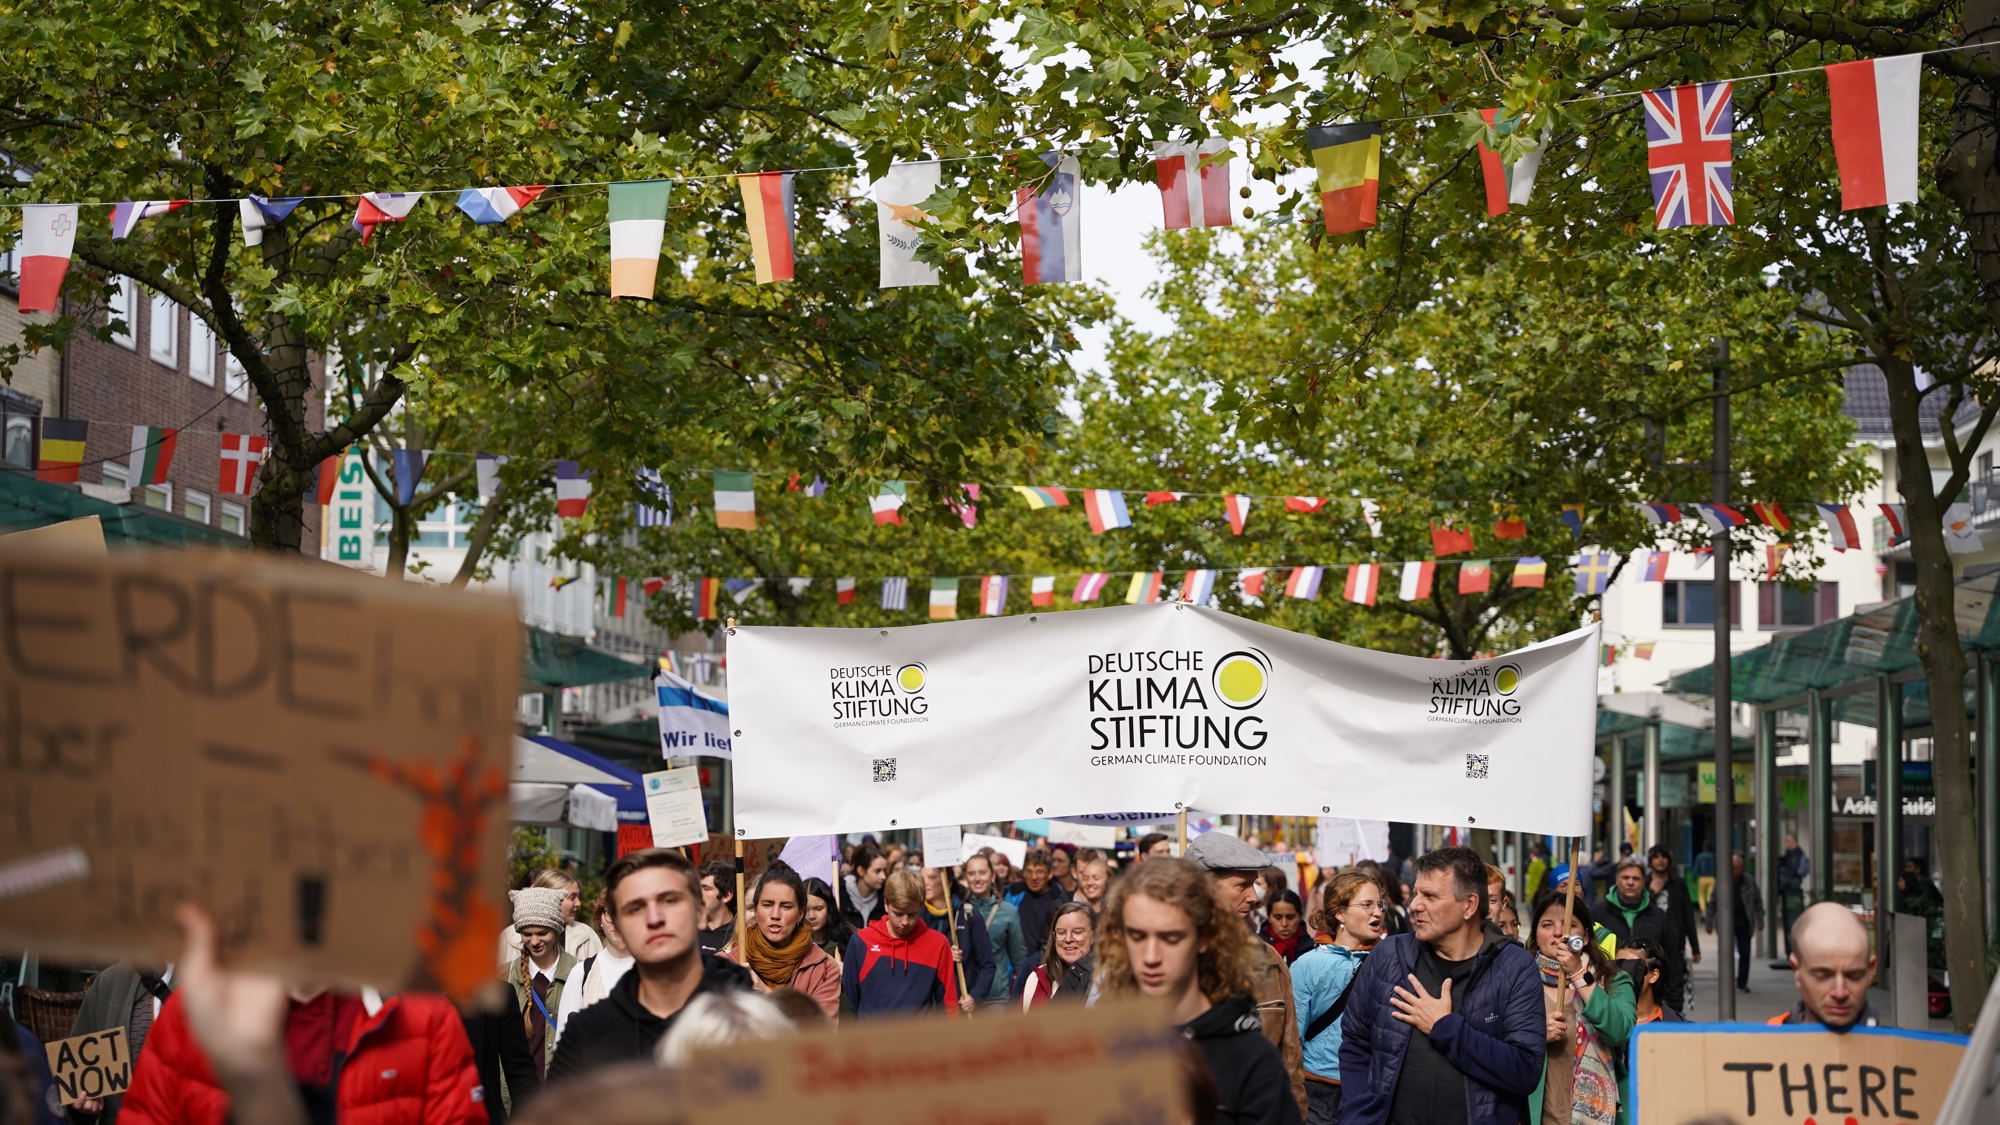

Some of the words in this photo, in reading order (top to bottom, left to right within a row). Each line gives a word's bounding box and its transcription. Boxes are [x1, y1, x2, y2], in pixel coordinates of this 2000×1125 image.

[830, 665, 892, 679] DEUTSCHE
[1088, 650, 1204, 674] DEUTSCHE
[831, 679, 896, 700] KLIMA
[1089, 677, 1208, 712] KLIMA
[1432, 678, 1491, 696] KLIMA
[833, 696, 929, 720] STIFTUNG
[1429, 696, 1521, 717] STIFTUNG
[833, 721, 861, 729] GERMAN
[861, 719, 886, 727] CLIMATE
[887, 716, 929, 725] FOUNDATION
[1427, 715, 1454, 723] GERMAN
[1454, 717, 1479, 725] CLIMATE
[1479, 717, 1522, 725] FOUNDATION
[663, 731, 697, 749] Wir
[1090, 715, 1268, 750] STIFTUNG
[1091, 754, 1143, 767] GERMAN
[1145, 753, 1186, 765] CLIMATE
[1189, 754, 1267, 767] FOUNDATION
[57, 1031, 120, 1074] ACT
[54, 1062, 129, 1104] NOW
[1722, 1062, 1920, 1120] THERE
